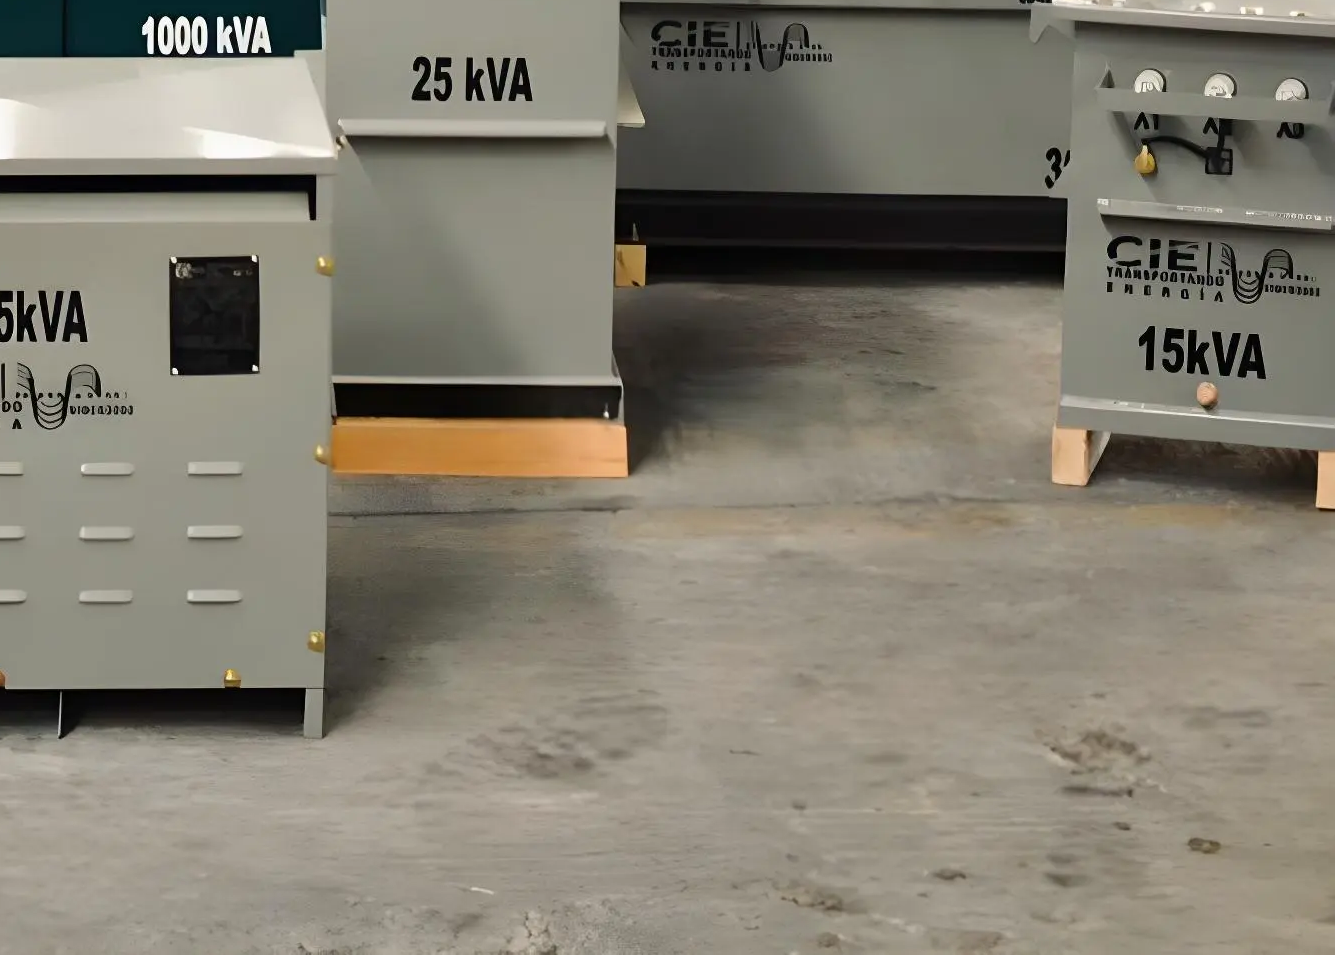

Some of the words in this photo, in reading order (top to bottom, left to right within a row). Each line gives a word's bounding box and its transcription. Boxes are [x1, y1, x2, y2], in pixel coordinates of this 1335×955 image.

[141, 15, 209, 56] 1000
[216, 15, 273, 54] kVA
[650, 19, 731, 48] CIE
[411, 56, 453, 102] 25
[465, 56, 533, 102] kVA
[1106, 235, 1200, 272] CIE
[1137, 325, 1268, 380] 15kVA
